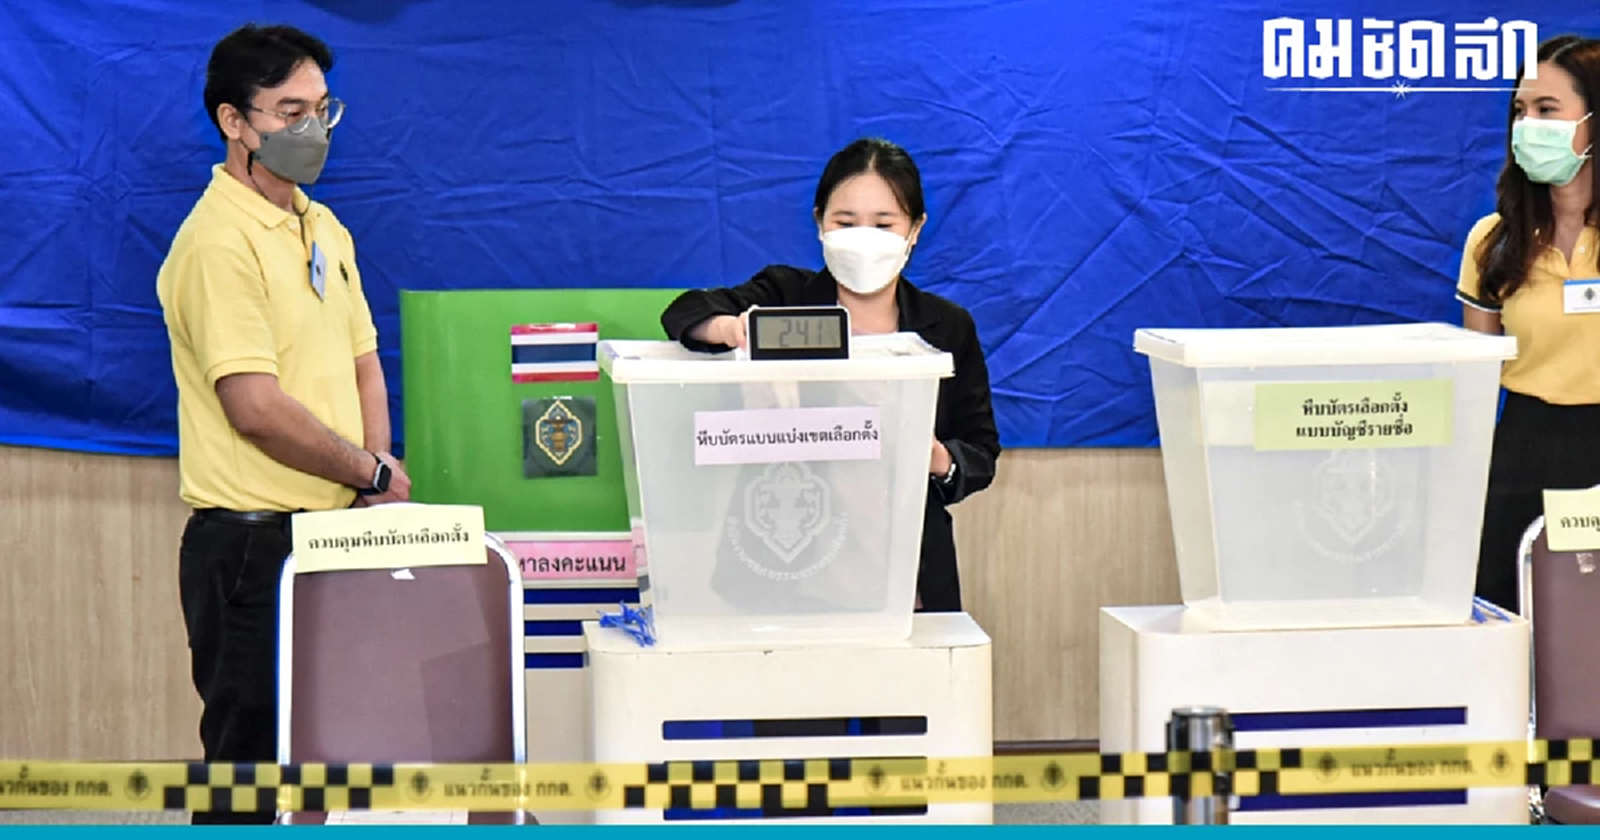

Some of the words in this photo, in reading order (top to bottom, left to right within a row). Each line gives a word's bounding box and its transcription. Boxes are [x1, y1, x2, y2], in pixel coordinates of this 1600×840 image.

[696, 420, 879, 447] หีบบัตรแบบแบ่งเขตเลือกตั้ง
